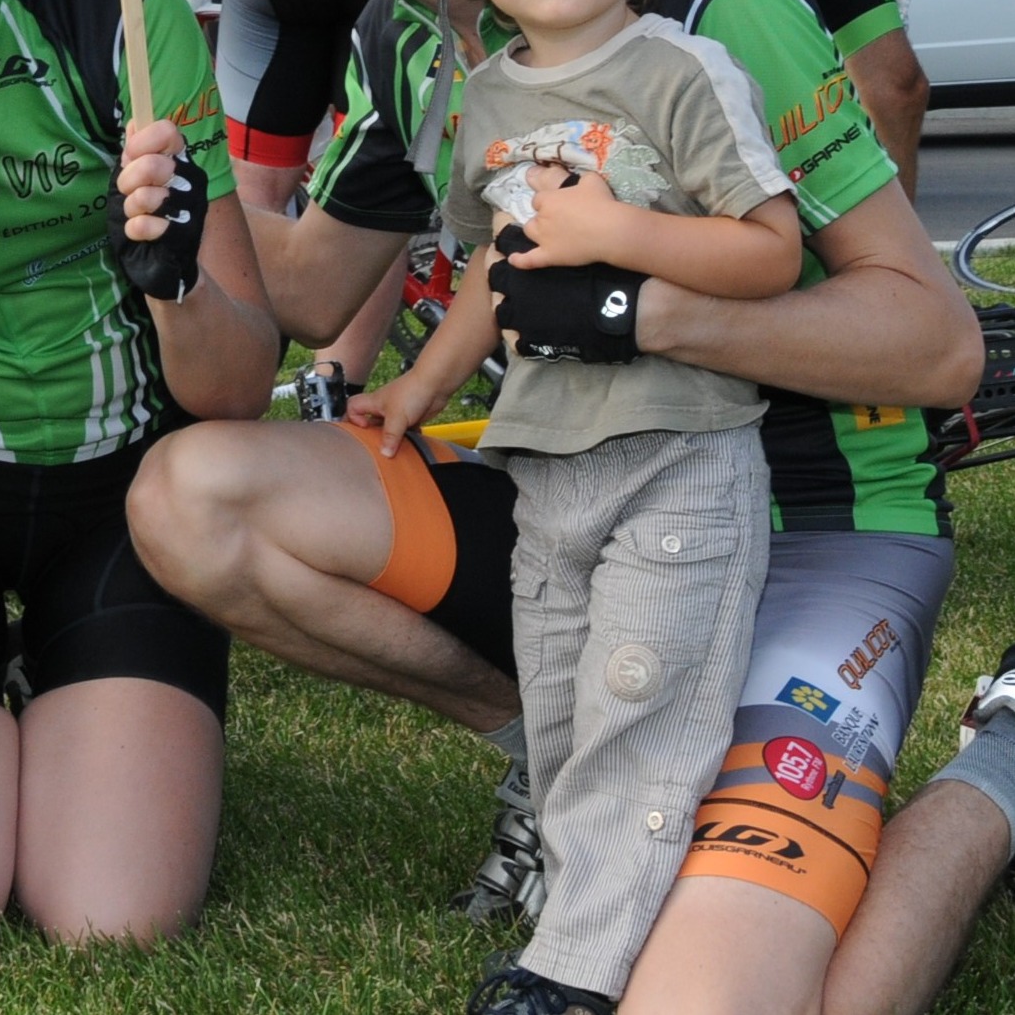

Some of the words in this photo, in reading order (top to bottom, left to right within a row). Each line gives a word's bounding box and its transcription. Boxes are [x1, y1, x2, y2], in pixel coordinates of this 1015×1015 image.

[2, 143, 81, 199] VIE
[800, 122, 862, 175] GARNE
[78, 195, 108, 219] 20
[832, 706, 863, 746] BANQUE
[774, 740, 814, 785] 105.7
